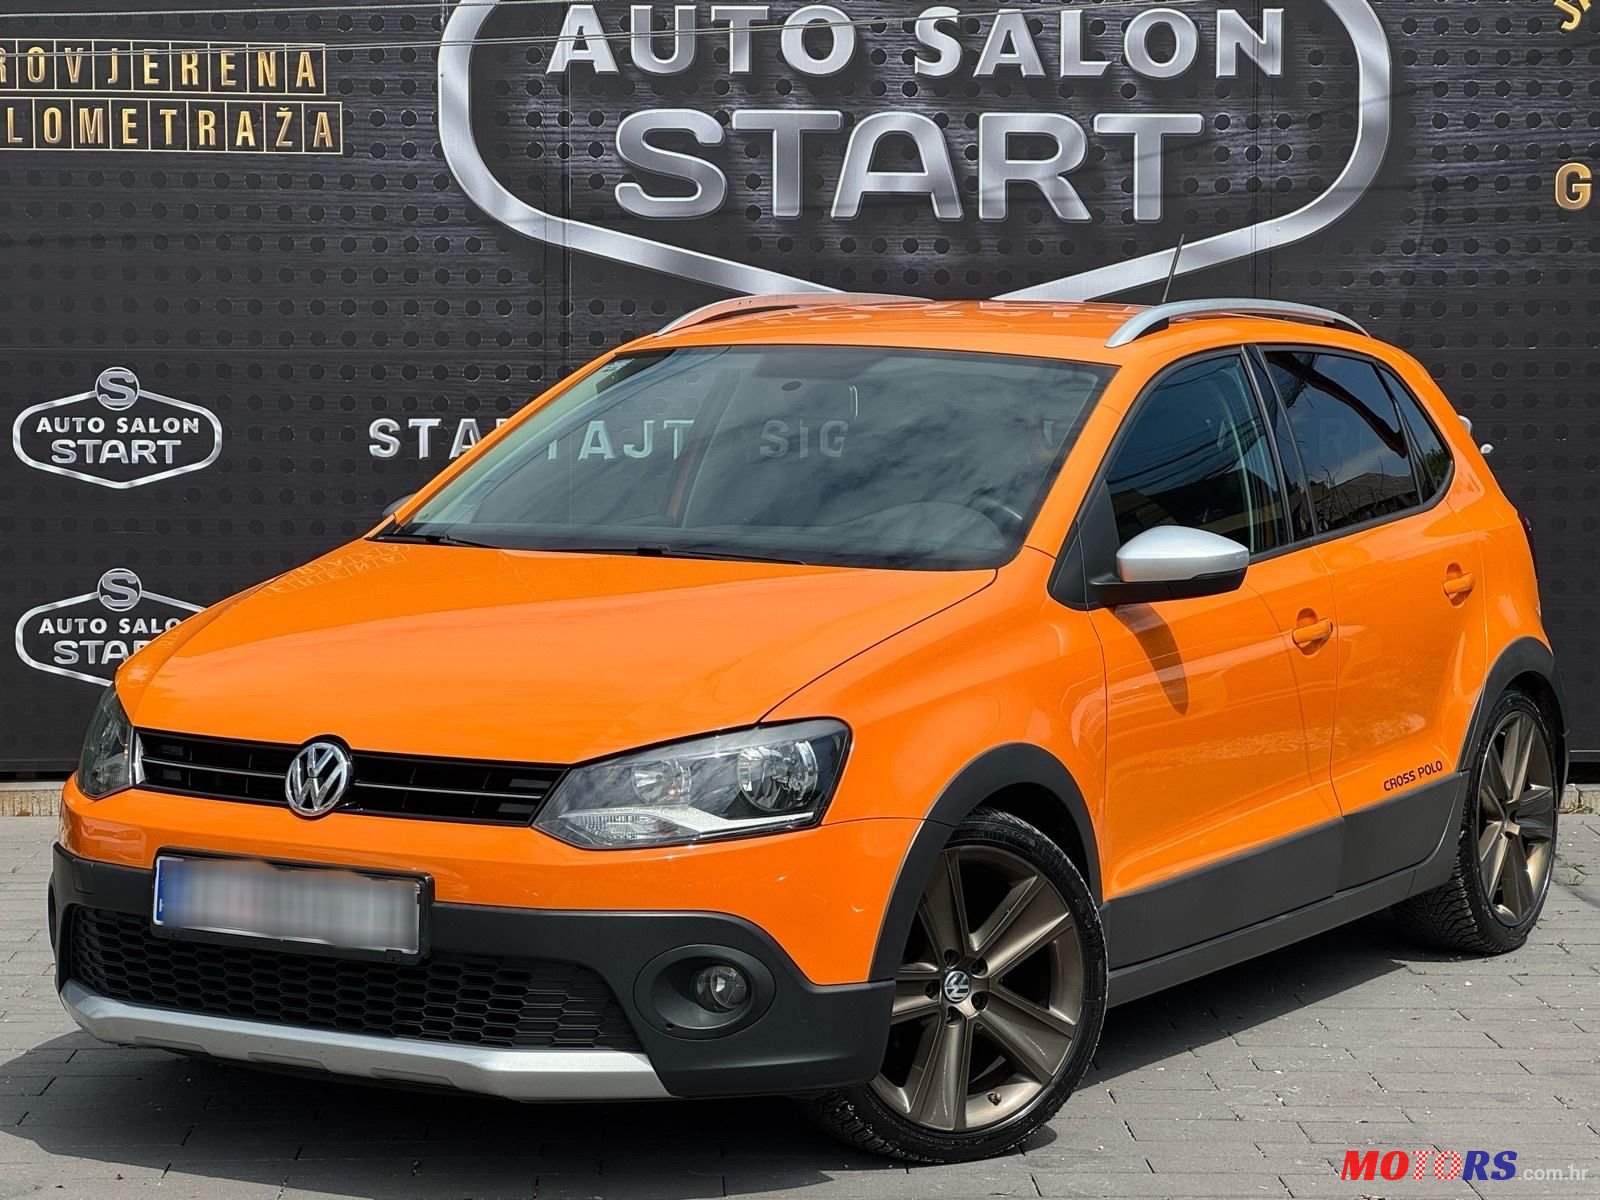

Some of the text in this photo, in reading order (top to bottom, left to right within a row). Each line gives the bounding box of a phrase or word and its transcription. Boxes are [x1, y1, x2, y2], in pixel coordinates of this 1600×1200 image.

[545, 4, 1284, 78] AUTO SALON
[615, 108, 1204, 222] START
[99, 371, 136, 407] S
[36, 417, 199, 434] AUTO SALON
[51, 439, 182, 464] START
[101, 572, 138, 607] S
[39, 618, 107, 634] AUTO
[1383, 760, 1443, 791] CROSS POLO
